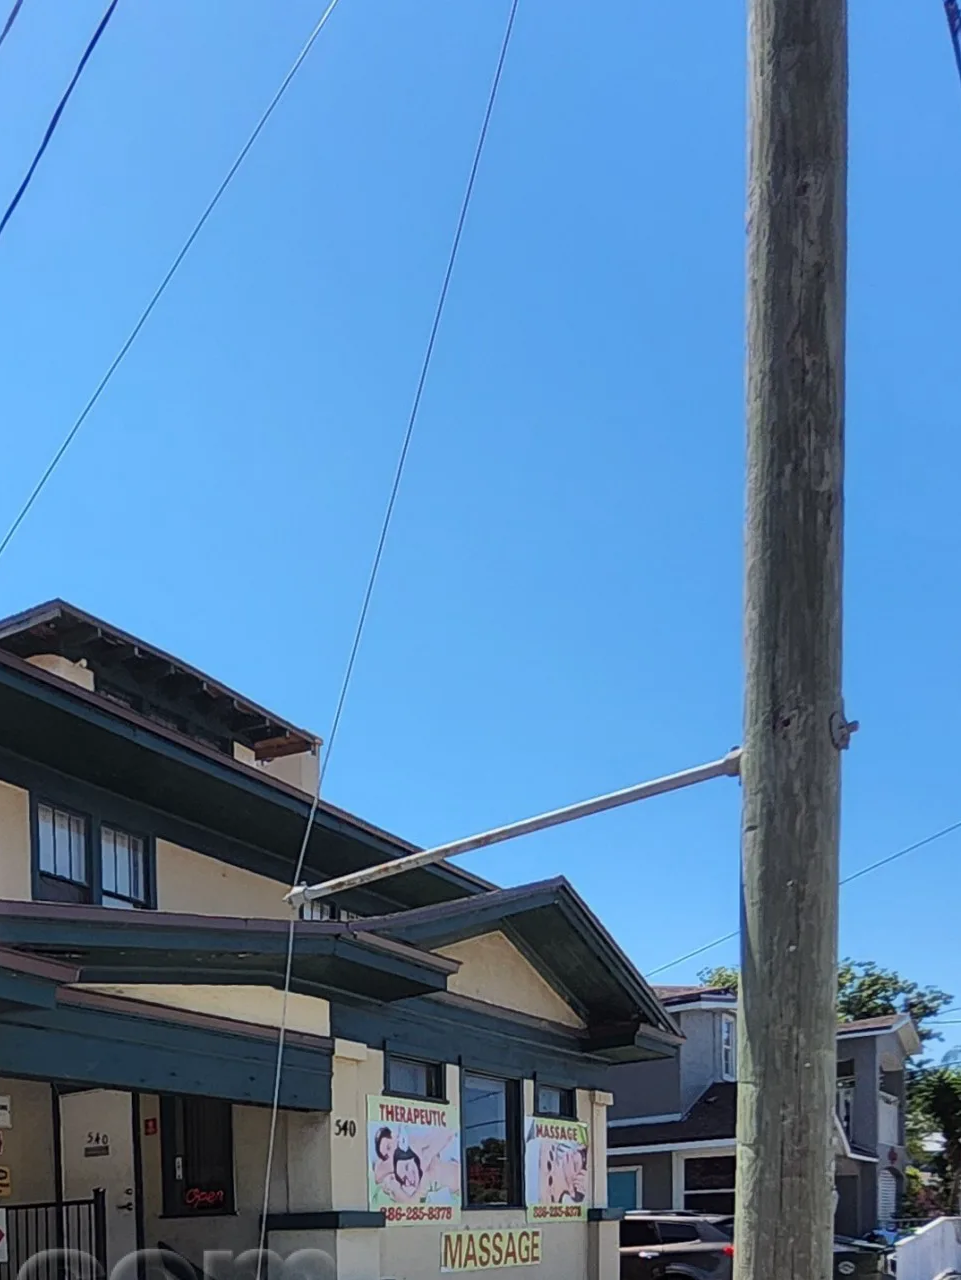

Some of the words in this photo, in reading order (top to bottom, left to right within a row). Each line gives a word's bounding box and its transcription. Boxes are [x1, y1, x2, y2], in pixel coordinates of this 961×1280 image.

[379, 1103, 447, 1128] THERAPEUTIC
[334, 1119, 356, 1138] 540
[536, 1123, 579, 1141] MASSAGE
[87, 1132, 109, 1145] 540
[186, 1188, 225, 1208] Open
[442, 1230, 541, 1270] MASSAGE
